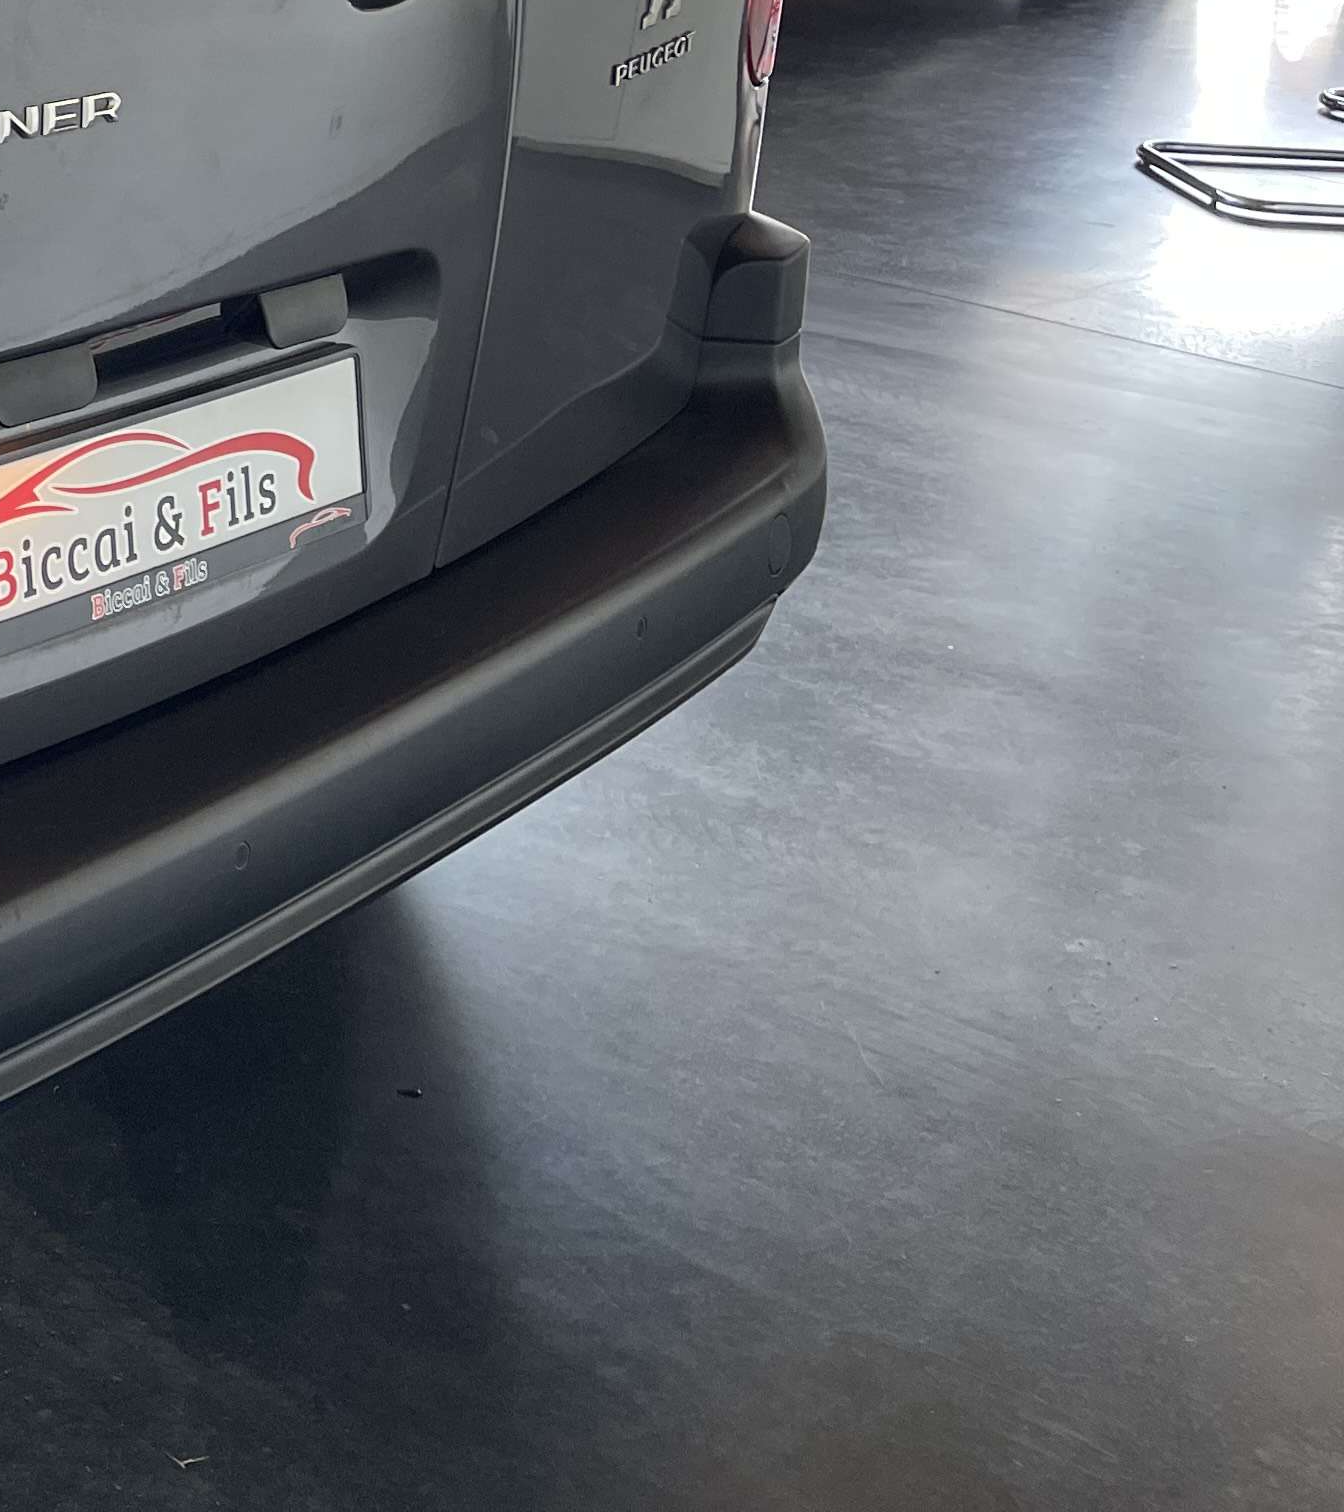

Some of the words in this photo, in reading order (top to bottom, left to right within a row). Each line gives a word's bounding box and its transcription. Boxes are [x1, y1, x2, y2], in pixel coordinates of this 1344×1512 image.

[611, 31, 696, 87] PEUGEOT
[154, 495, 185, 552] &
[198, 465, 277, 537] Fils
[91, 574, 153, 621] Biccai
[155, 568, 170, 596] &
[172, 559, 208, 590] Fils
